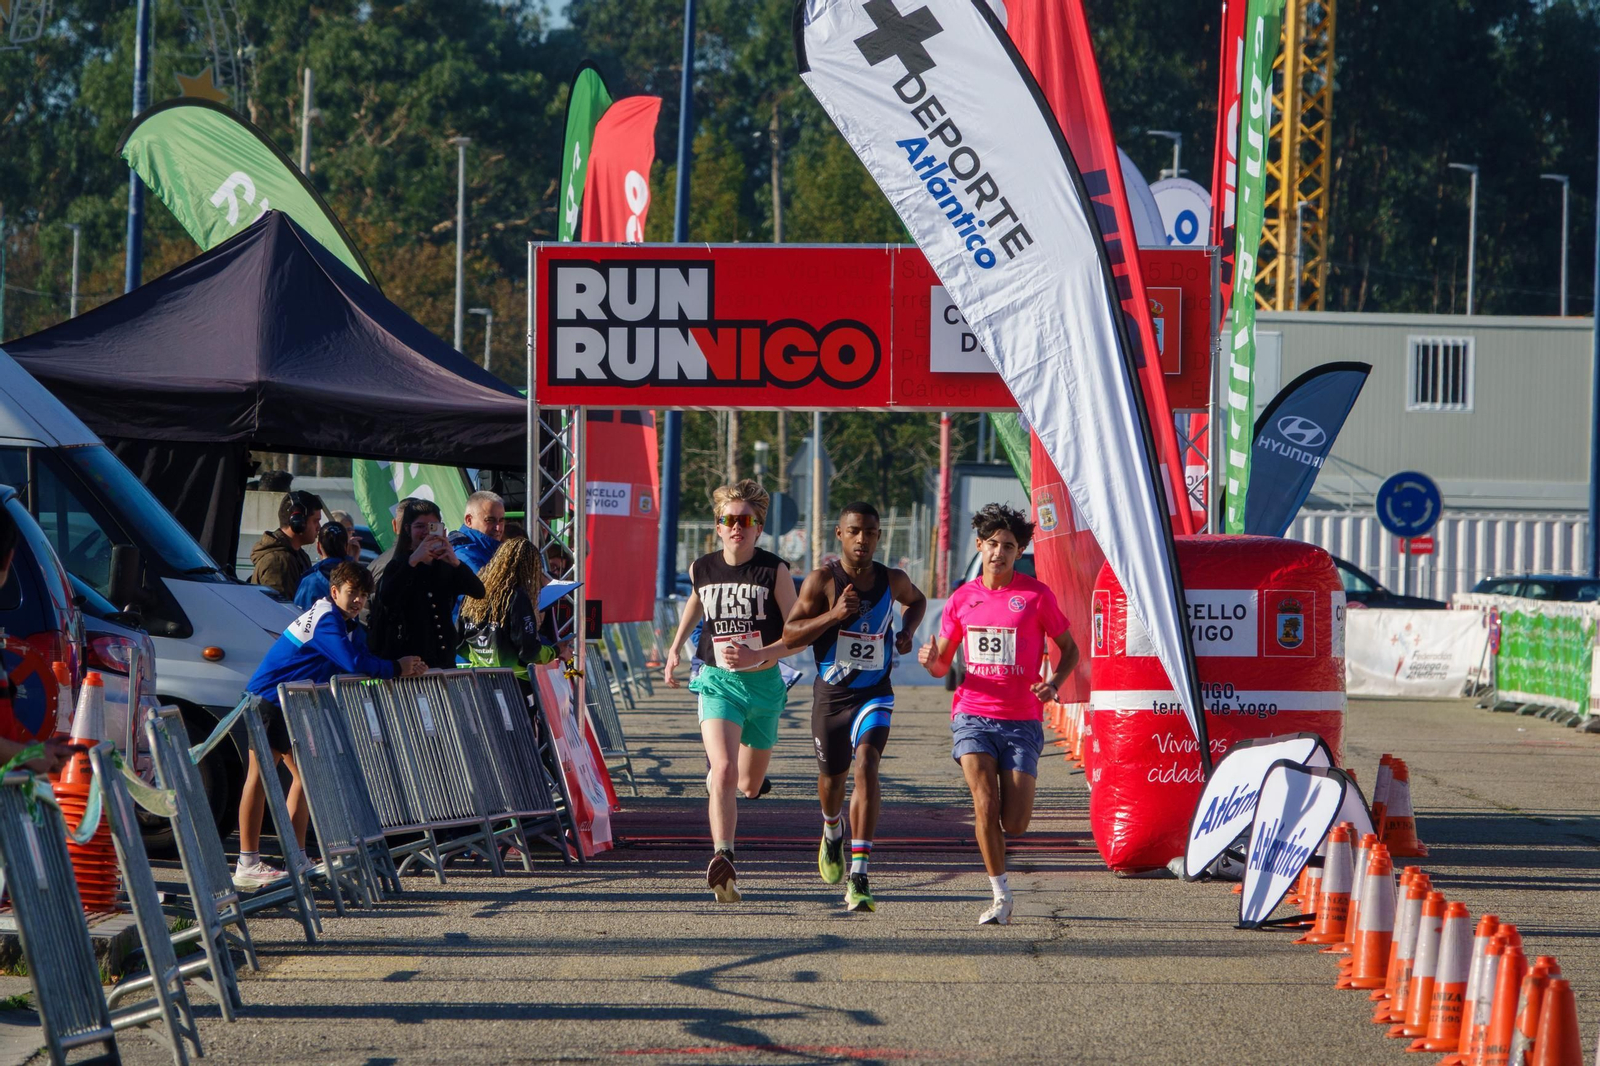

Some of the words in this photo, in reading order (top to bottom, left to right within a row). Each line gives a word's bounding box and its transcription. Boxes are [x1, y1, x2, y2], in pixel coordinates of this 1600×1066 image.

[892, 73, 1034, 260] DEPORTE
[895, 136, 997, 270] Atlántico
[556, 267, 709, 321] RUN
[1257, 435, 1325, 469] HYUNDAI
[585, 488, 626, 499] NCELLO
[594, 499, 619, 508] VIGO
[698, 582, 770, 622] WEST
[714, 620, 754, 635] COAST
[849, 642, 875, 660] 82
[978, 636, 1002, 653] 83
[1152, 700, 1182, 715] terr
[1211, 702, 1231, 715] de
[1237, 704, 1278, 719] xogo
[1248, 817, 1310, 879] Atlántico
